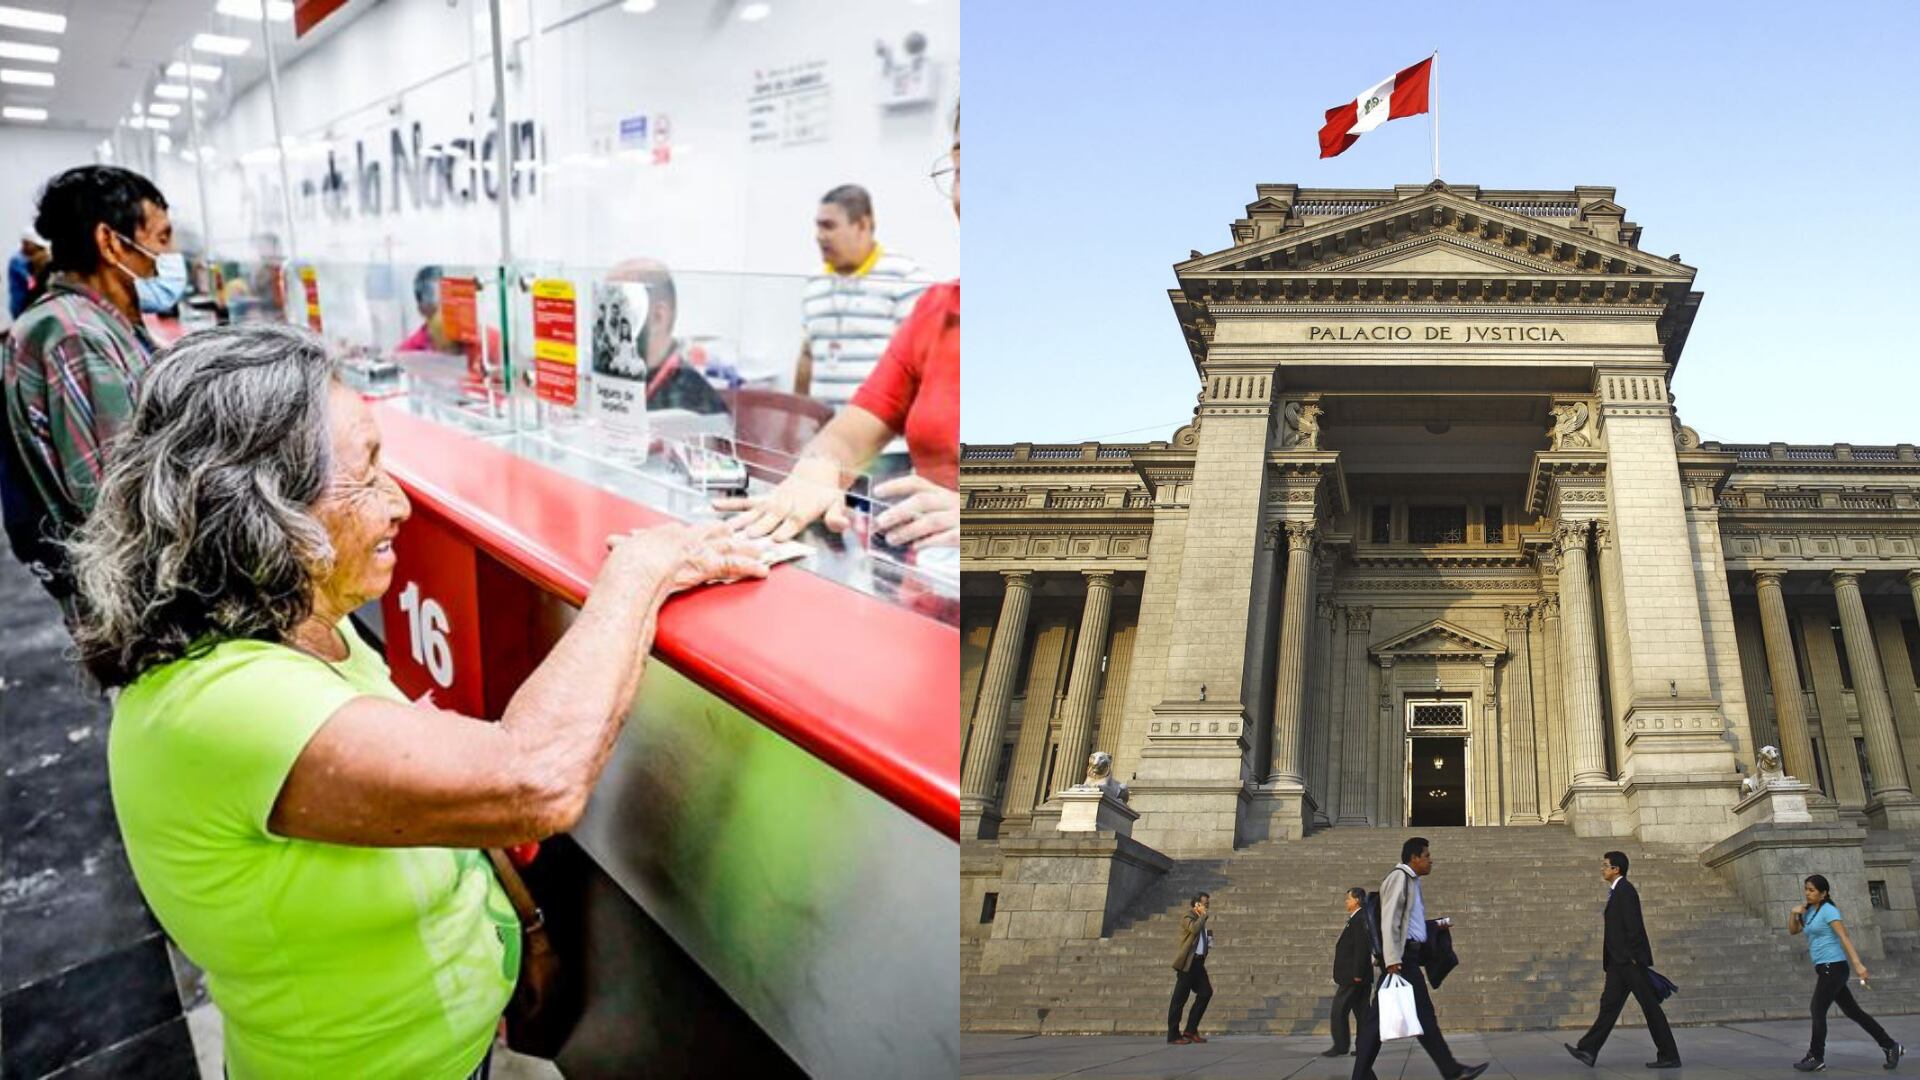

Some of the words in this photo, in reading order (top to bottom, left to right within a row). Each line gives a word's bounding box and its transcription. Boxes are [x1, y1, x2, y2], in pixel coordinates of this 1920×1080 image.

[1309, 326, 1412, 341] PALACIO
[1424, 326, 1453, 341] DE
[1464, 326, 1566, 343] JVSTICIA
[399, 581, 454, 688] 16
